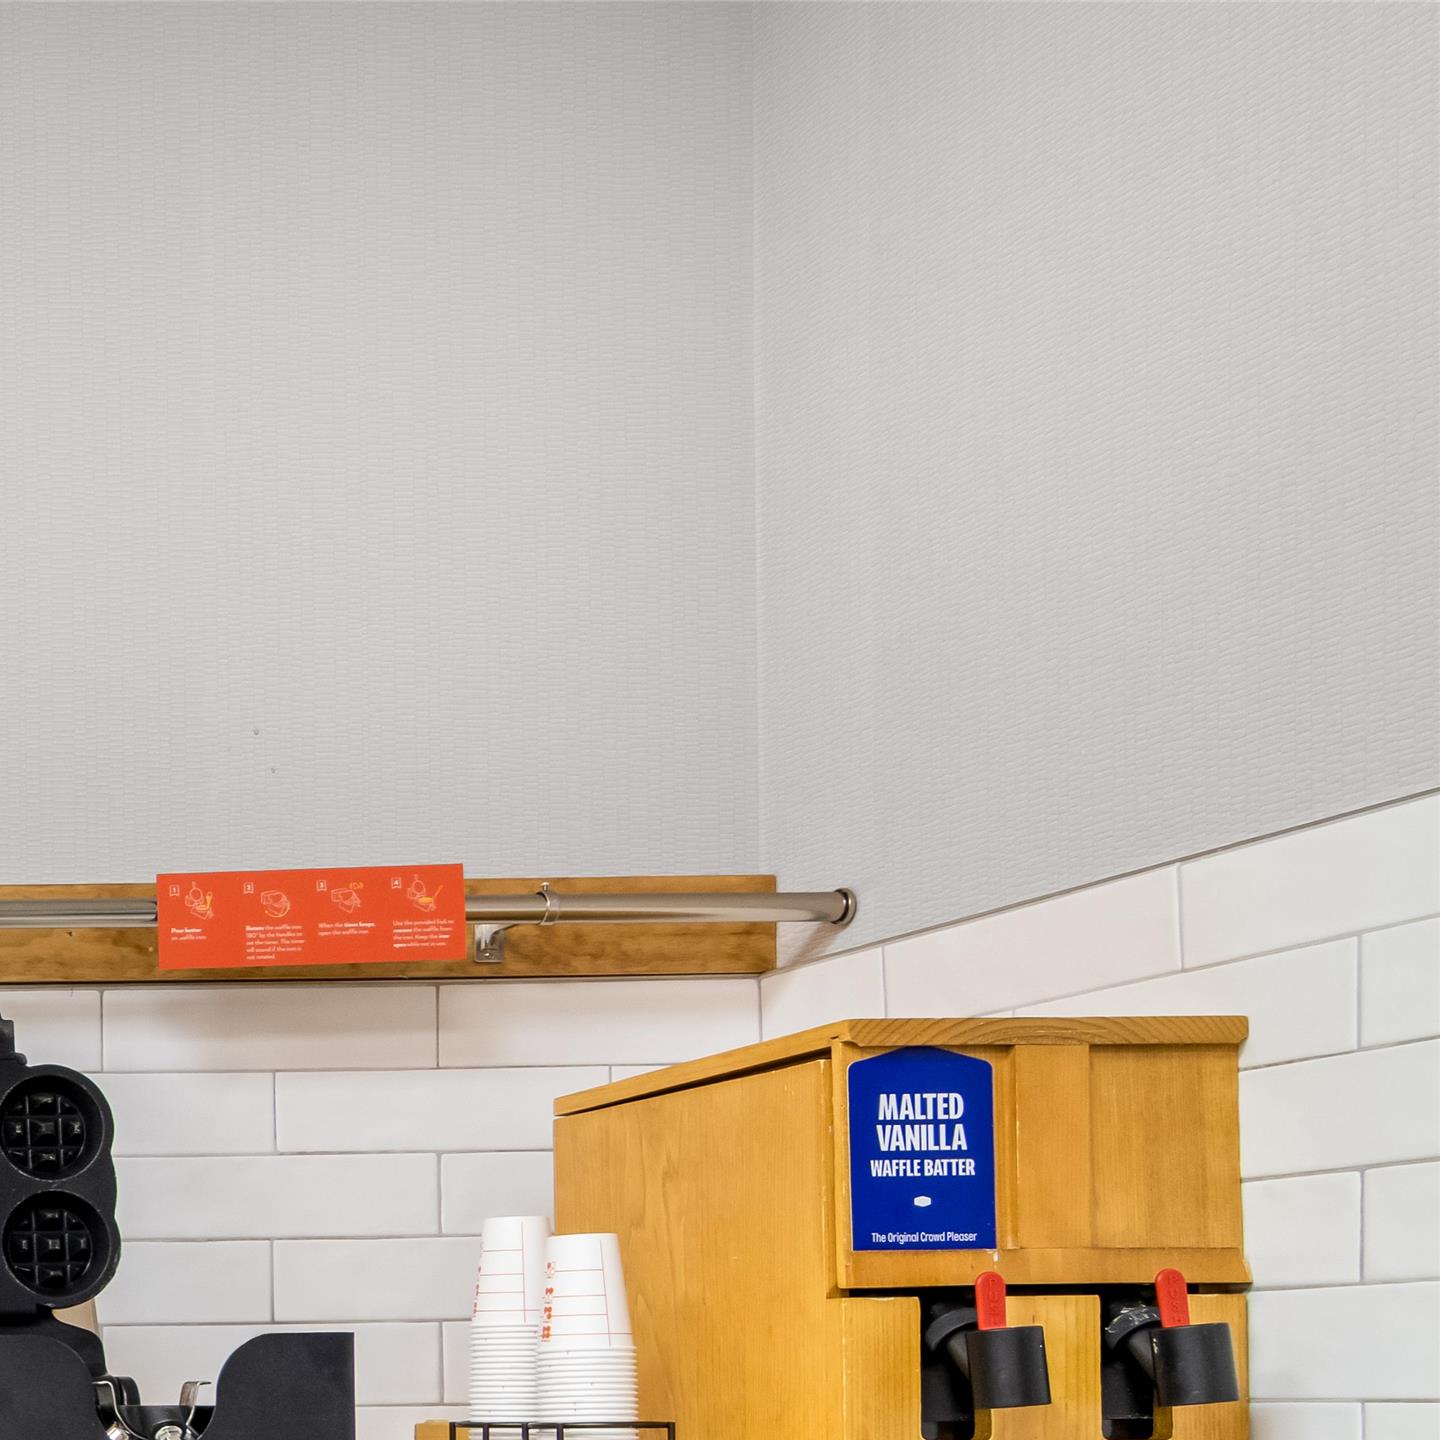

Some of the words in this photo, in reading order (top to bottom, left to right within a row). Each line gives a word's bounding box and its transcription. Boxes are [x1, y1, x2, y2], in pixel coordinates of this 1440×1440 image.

[878, 1093, 964, 1120] MALTED
[876, 1124, 968, 1151] VANILLA
[870, 1160, 921, 1176] WAFFLE
[924, 1159, 975, 1176] BATTER
[872, 1233, 886, 1242] The
[888, 1232, 919, 1244] Original
[920, 1232, 945, 1242] Crowd
[947, 1232, 978, 1242] Pleaser
